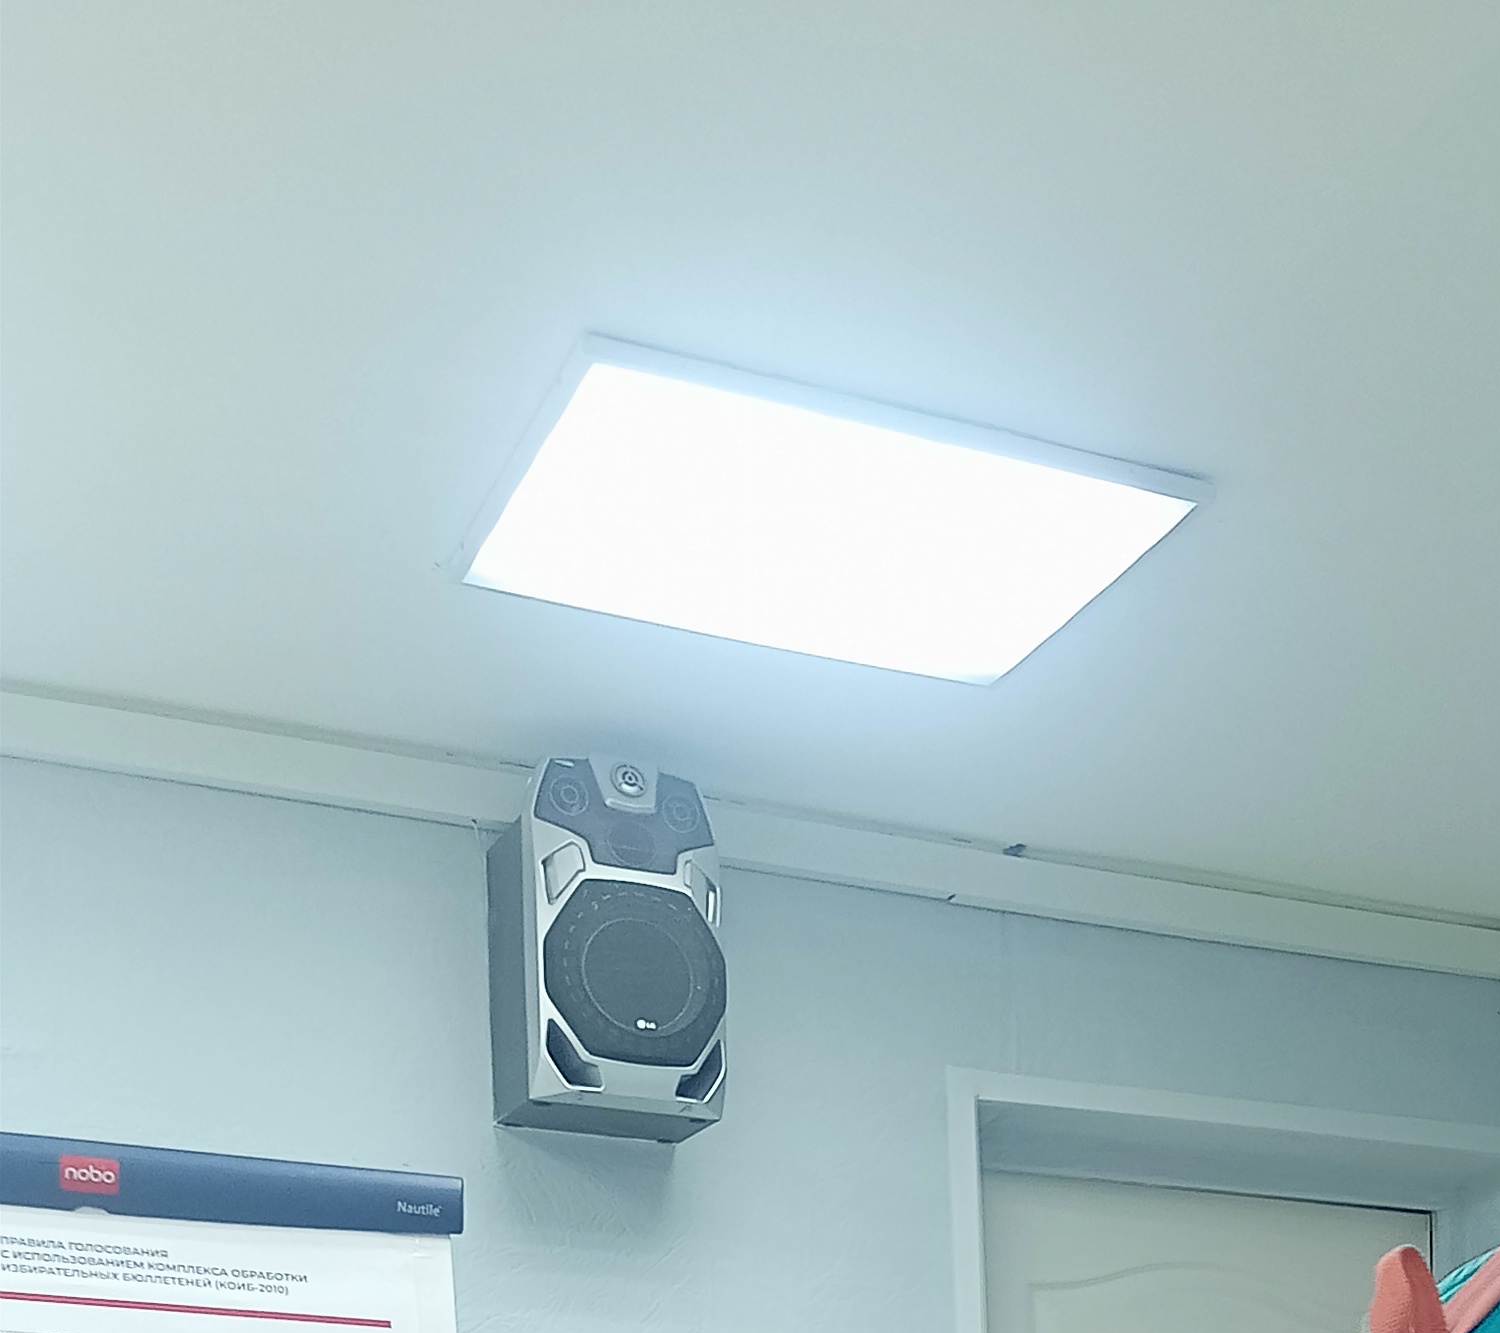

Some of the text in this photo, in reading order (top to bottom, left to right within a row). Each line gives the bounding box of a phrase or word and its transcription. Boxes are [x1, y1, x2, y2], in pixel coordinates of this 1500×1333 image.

[64, 1164, 117, 1184] nobo
[397, 1200, 440, 1217] Nautile
[0, 1235, 169, 1259] ПРАВИЛА ГОЛОСОВАНИЯ
[0, 1250, 308, 1284] С ИСПОЛЬЗОВАНИЕМ КОМПЛЕКСА ОБРАБОТКИ
[0, 1263, 289, 1296] ИЗБИРАТЕЛЬНЫХ БЮЛЛЕТЕНЕЙ (КОИБ-2010)
